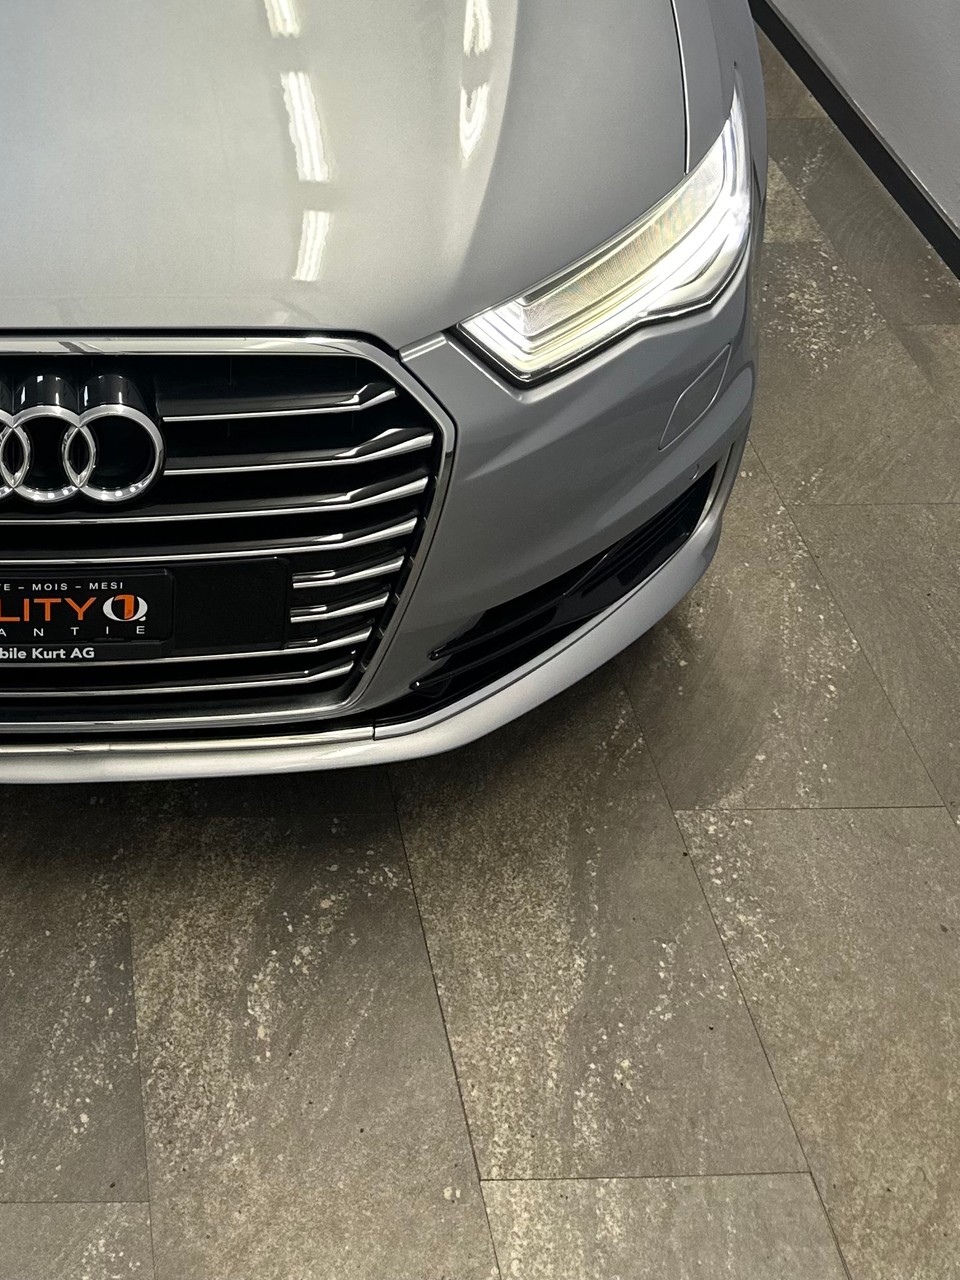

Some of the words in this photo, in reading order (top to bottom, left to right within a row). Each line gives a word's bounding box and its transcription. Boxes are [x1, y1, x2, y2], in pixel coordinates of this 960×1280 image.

[32, 582, 68, 591] MOIS
[89, 581, 124, 590] MESI
[31, 647, 66, 659] Kurt
[69, 647, 95, 659] AG
